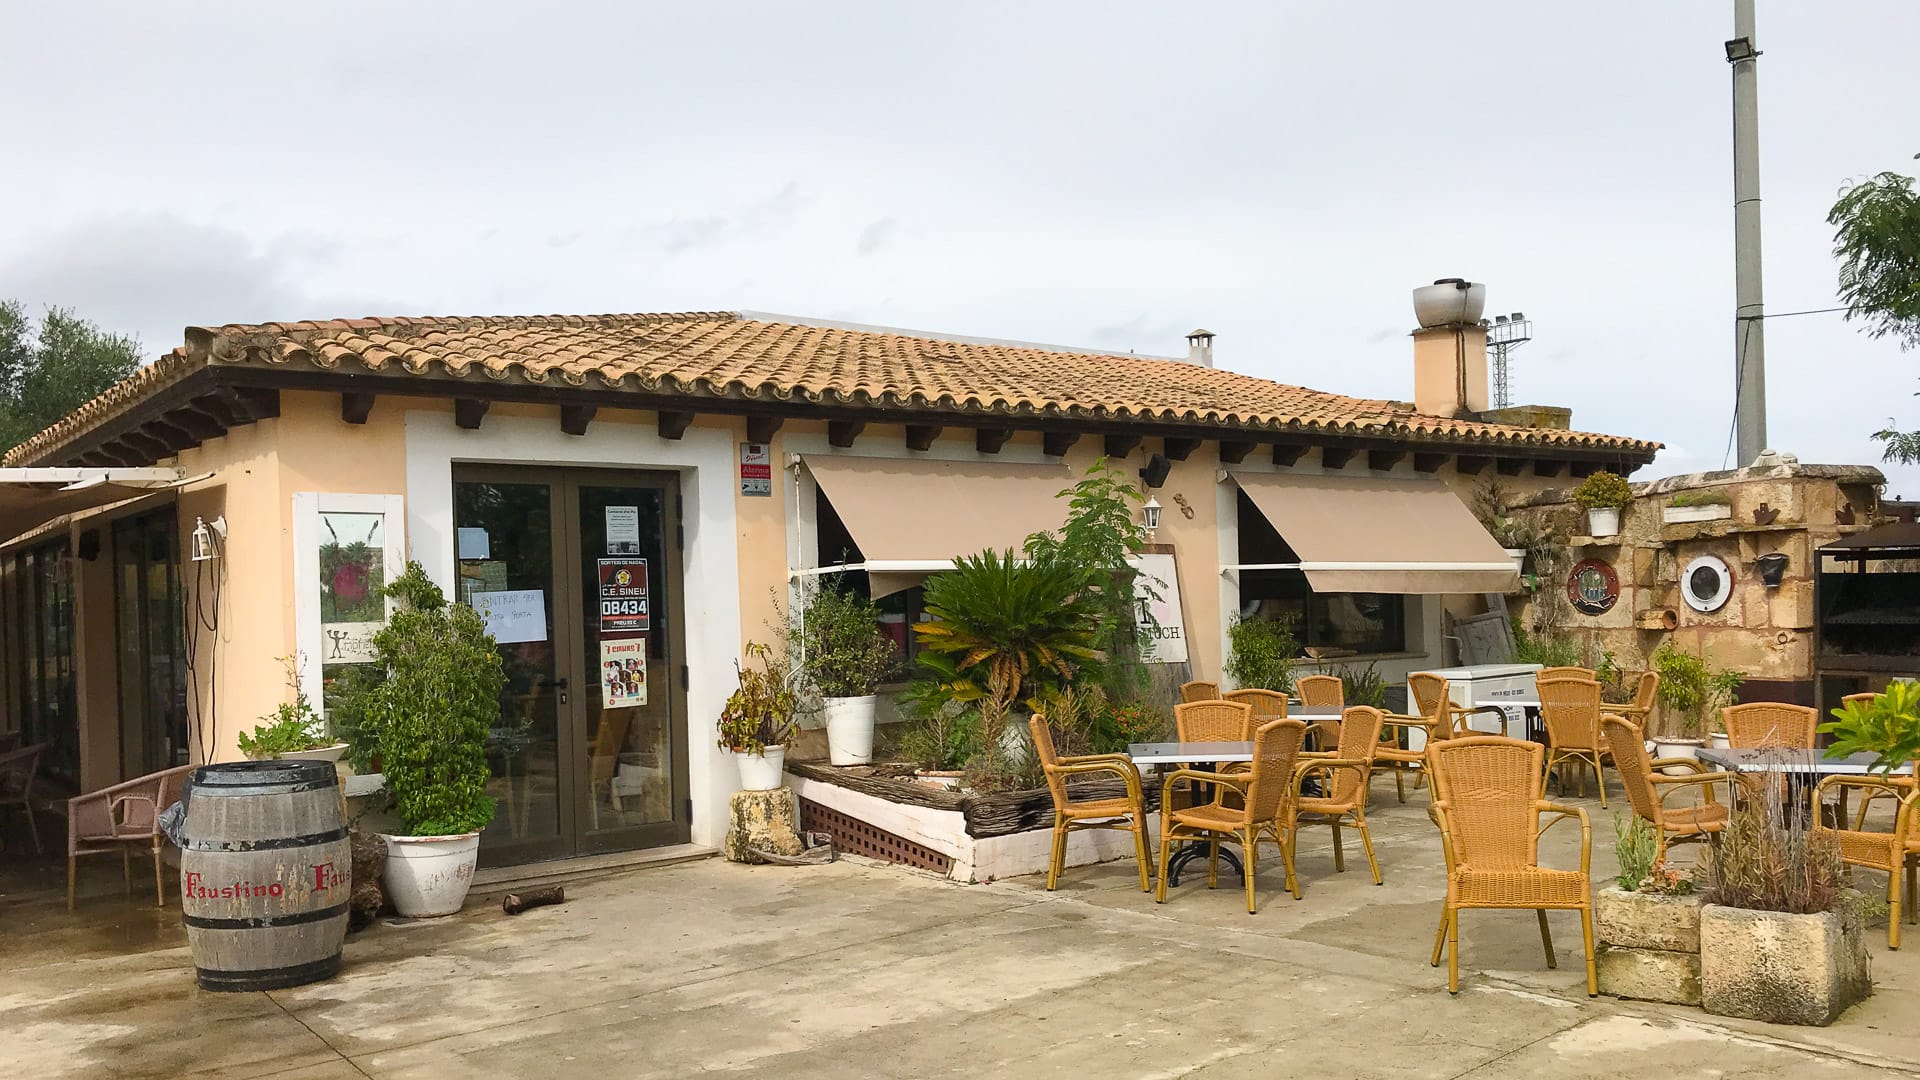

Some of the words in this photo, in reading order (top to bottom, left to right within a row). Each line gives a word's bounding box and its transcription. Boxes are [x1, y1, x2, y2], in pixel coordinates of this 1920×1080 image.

[602, 588, 618, 596] C.E.
[619, 587, 646, 596] SINEU
[602, 600, 647, 615] 08434
[185, 871, 283, 899] Faustino
